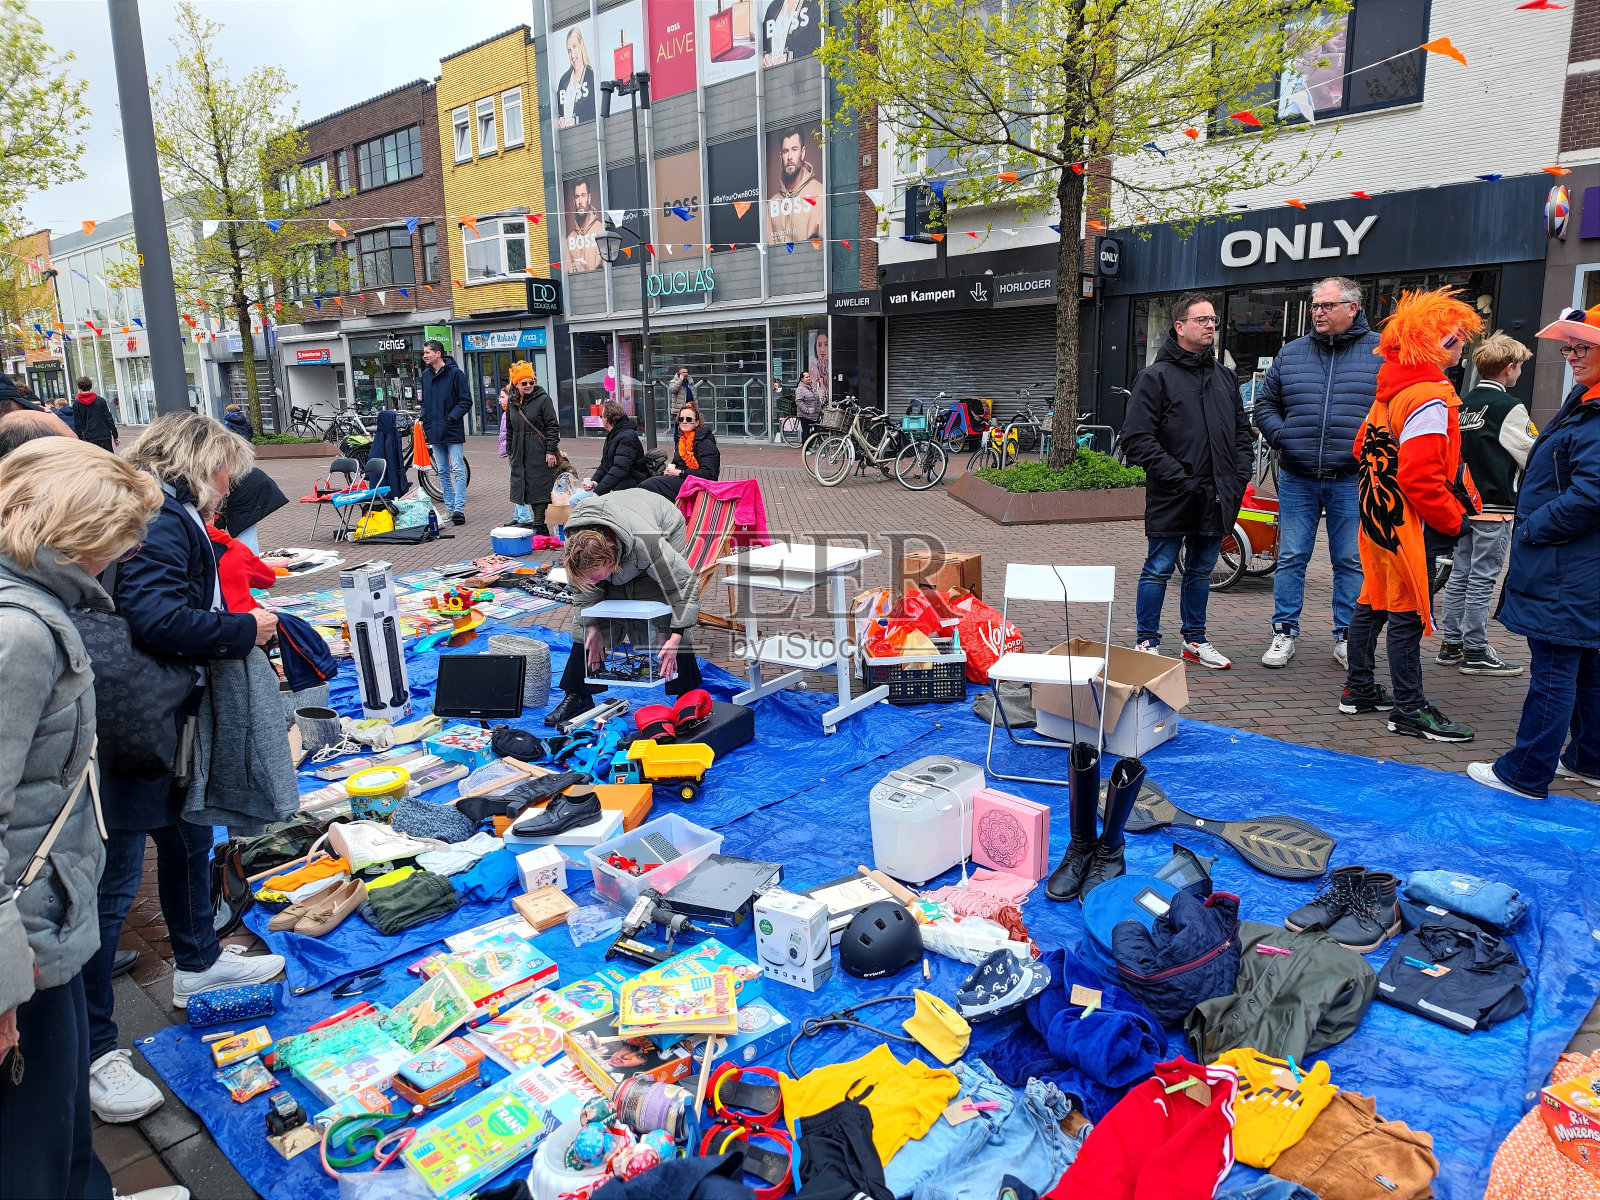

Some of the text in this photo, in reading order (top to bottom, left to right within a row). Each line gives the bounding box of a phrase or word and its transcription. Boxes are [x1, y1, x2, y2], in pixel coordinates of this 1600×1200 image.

[667, 22, 680, 33] BOSS
[766, 7, 809, 38] BOSS
[656, 32, 694, 63] ALIVE
[712, 188, 759, 203] #BeYourOwnBOSS
[663, 195, 698, 218] BOSS
[770, 196, 812, 218] BOSS
[568, 233, 596, 251] BOSS
[1220, 214, 1379, 268] ONLY
[1100, 251, 1119, 263] ONLY
[1000, 279, 1051, 293] HORLOGER
[834, 296, 870, 308] JUWELIER
[889, 288, 956, 304] van Kampen
[379, 339, 405, 350] ZIENGS
[860, 878, 880, 893] LACK
[714, 973, 728, 996] Donald
[715, 996, 730, 1015] Duck
[493, 1105, 526, 1135] FRANS
